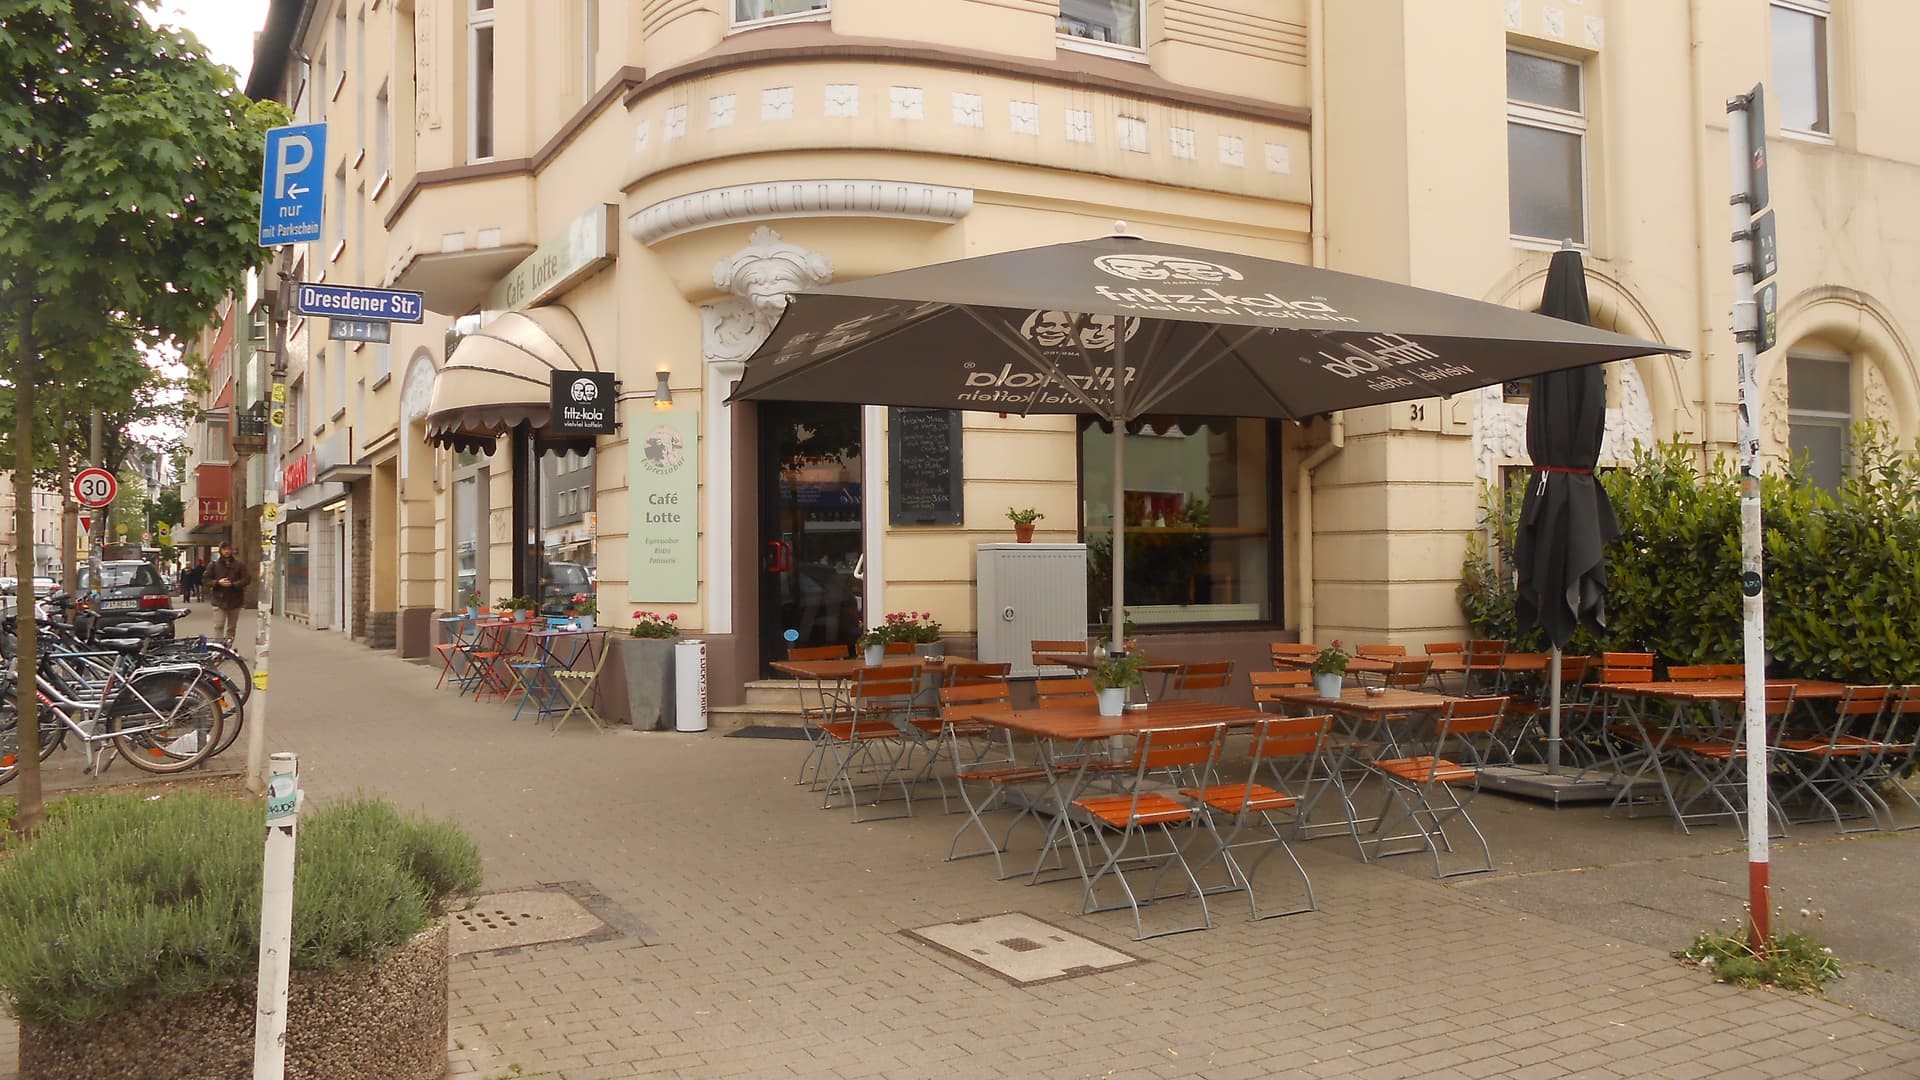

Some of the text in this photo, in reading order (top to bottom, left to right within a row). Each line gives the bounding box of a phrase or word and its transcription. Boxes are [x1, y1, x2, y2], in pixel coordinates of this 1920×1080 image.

[275, 135, 314, 199] P
[280, 204, 303, 218] nur
[262, 221, 319, 238] mit Parkschein
[506, 255, 558, 308] Café Lotte
[304, 288, 417, 314] Dresdener Str.
[1094, 285, 1338, 313] fritz-kola
[1117, 303, 1359, 323] vielviel koffein
[564, 406, 603, 420] fritz-kola
[1410, 404, 1425, 420] 31
[564, 420, 603, 429] vielviel koffein
[83, 479, 107, 496] 30
[648, 493, 678, 505] Café
[645, 512, 681, 523] Lotte
